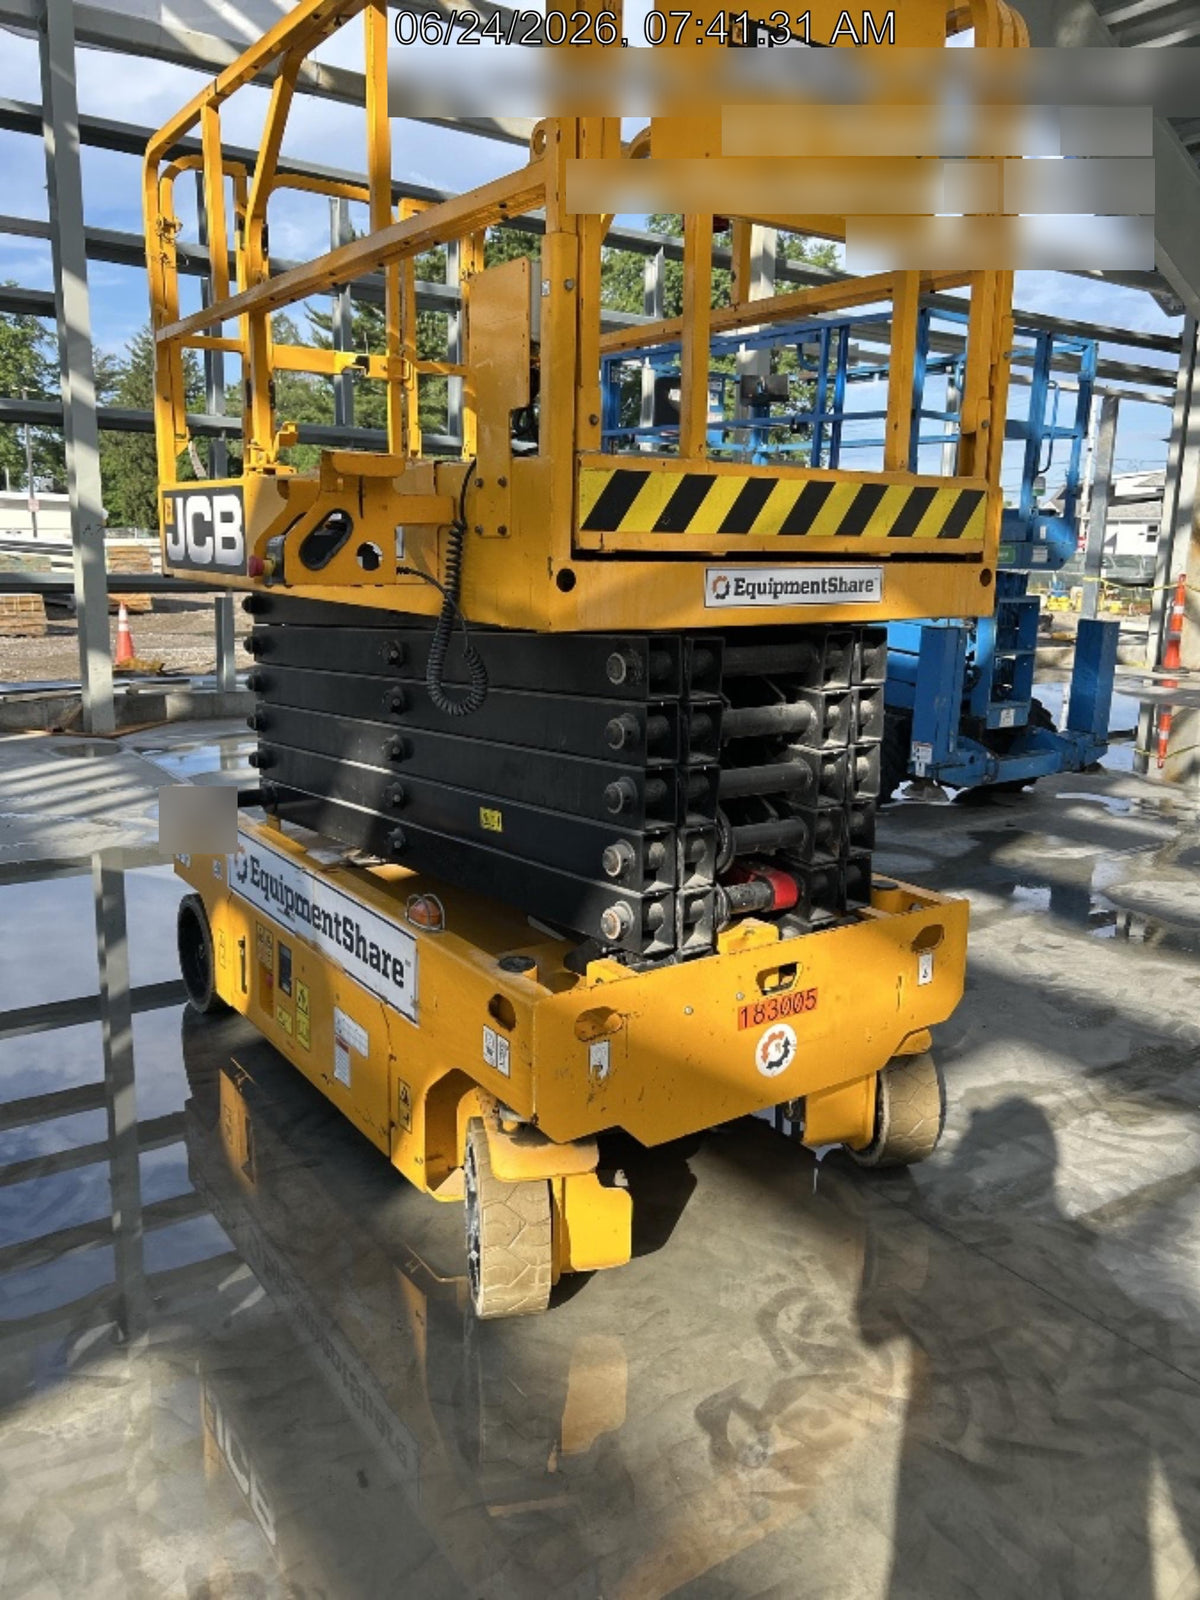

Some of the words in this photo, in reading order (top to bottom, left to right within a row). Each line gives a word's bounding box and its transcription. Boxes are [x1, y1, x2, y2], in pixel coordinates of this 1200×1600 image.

[165, 494, 244, 566] JCB
[733, 576, 875, 600] EquipmentShare
[249, 854, 405, 989] EquipmentShare
[740, 987, 818, 1029] 183005
